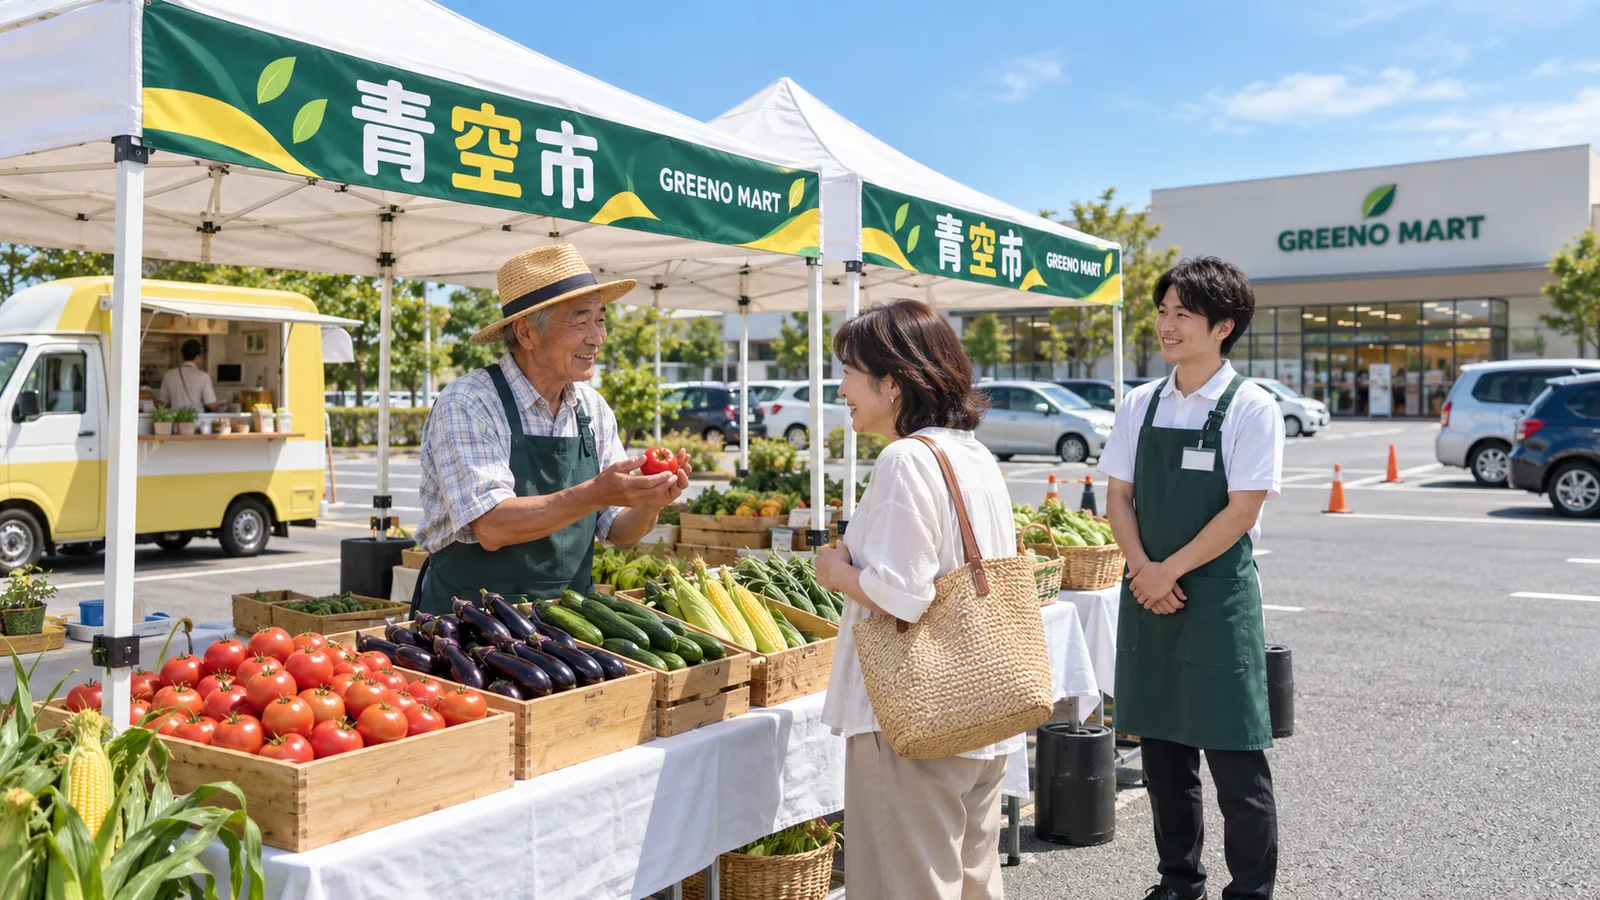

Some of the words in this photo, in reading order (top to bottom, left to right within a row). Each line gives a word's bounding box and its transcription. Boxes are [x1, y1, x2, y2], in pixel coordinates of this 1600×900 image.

[351, 79, 598, 209] 青空市
[659, 167, 733, 205] GREENO
[737, 183, 782, 214] MART
[934, 213, 1023, 282] 青空市
[1278, 223, 1390, 252] GREENO
[1398, 215, 1485, 243] MART
[1046, 252, 1079, 273] GREENO
[1080, 259, 1102, 277] MART
